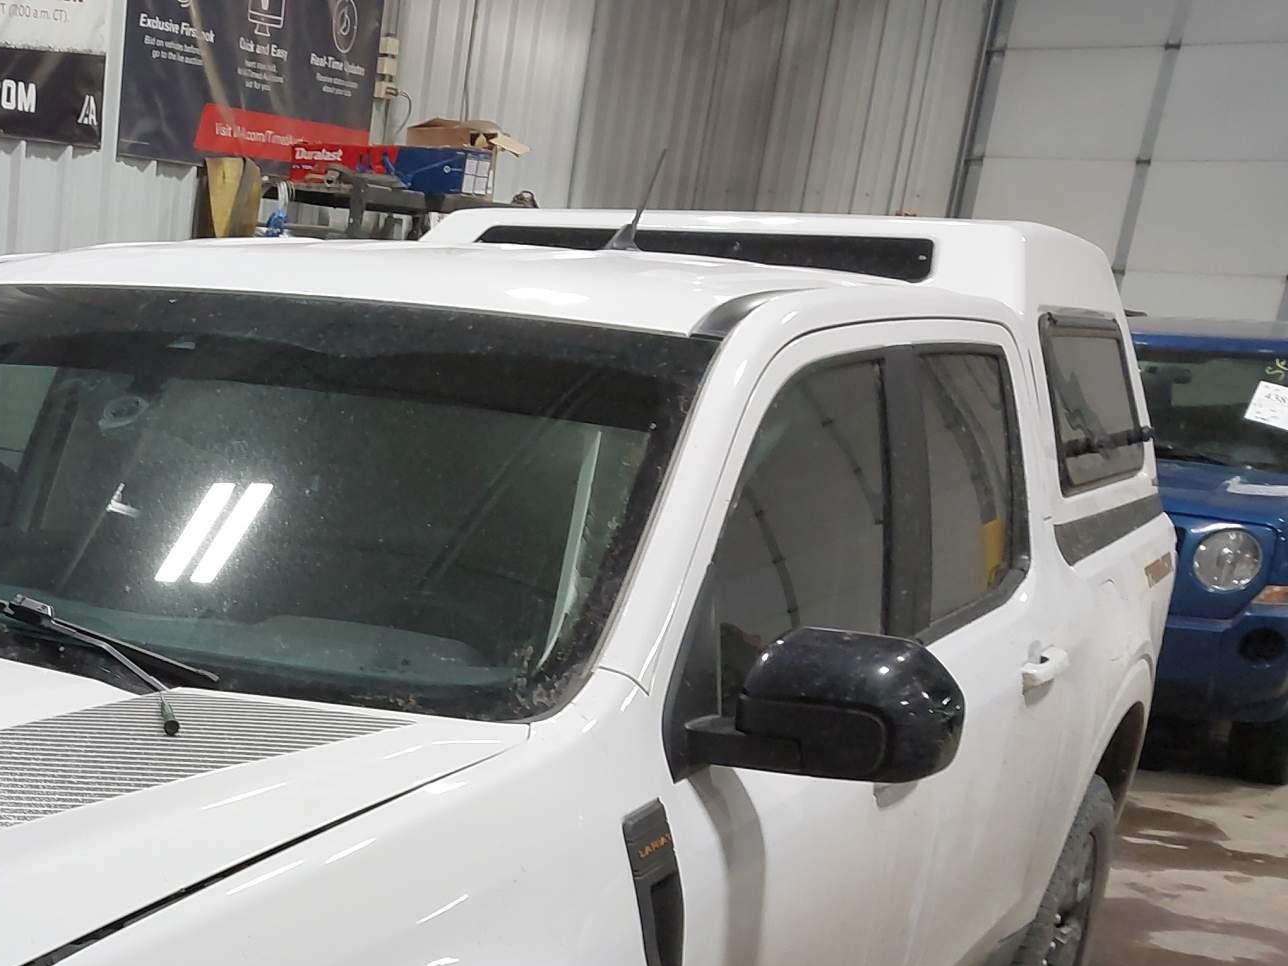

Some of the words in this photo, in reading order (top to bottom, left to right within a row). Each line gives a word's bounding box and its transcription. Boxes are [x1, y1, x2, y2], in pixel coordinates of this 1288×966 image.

[139, 12, 180, 35] Exclusive
[180, 21, 201, 40] Firs
[294, 146, 344, 162] Duralast
